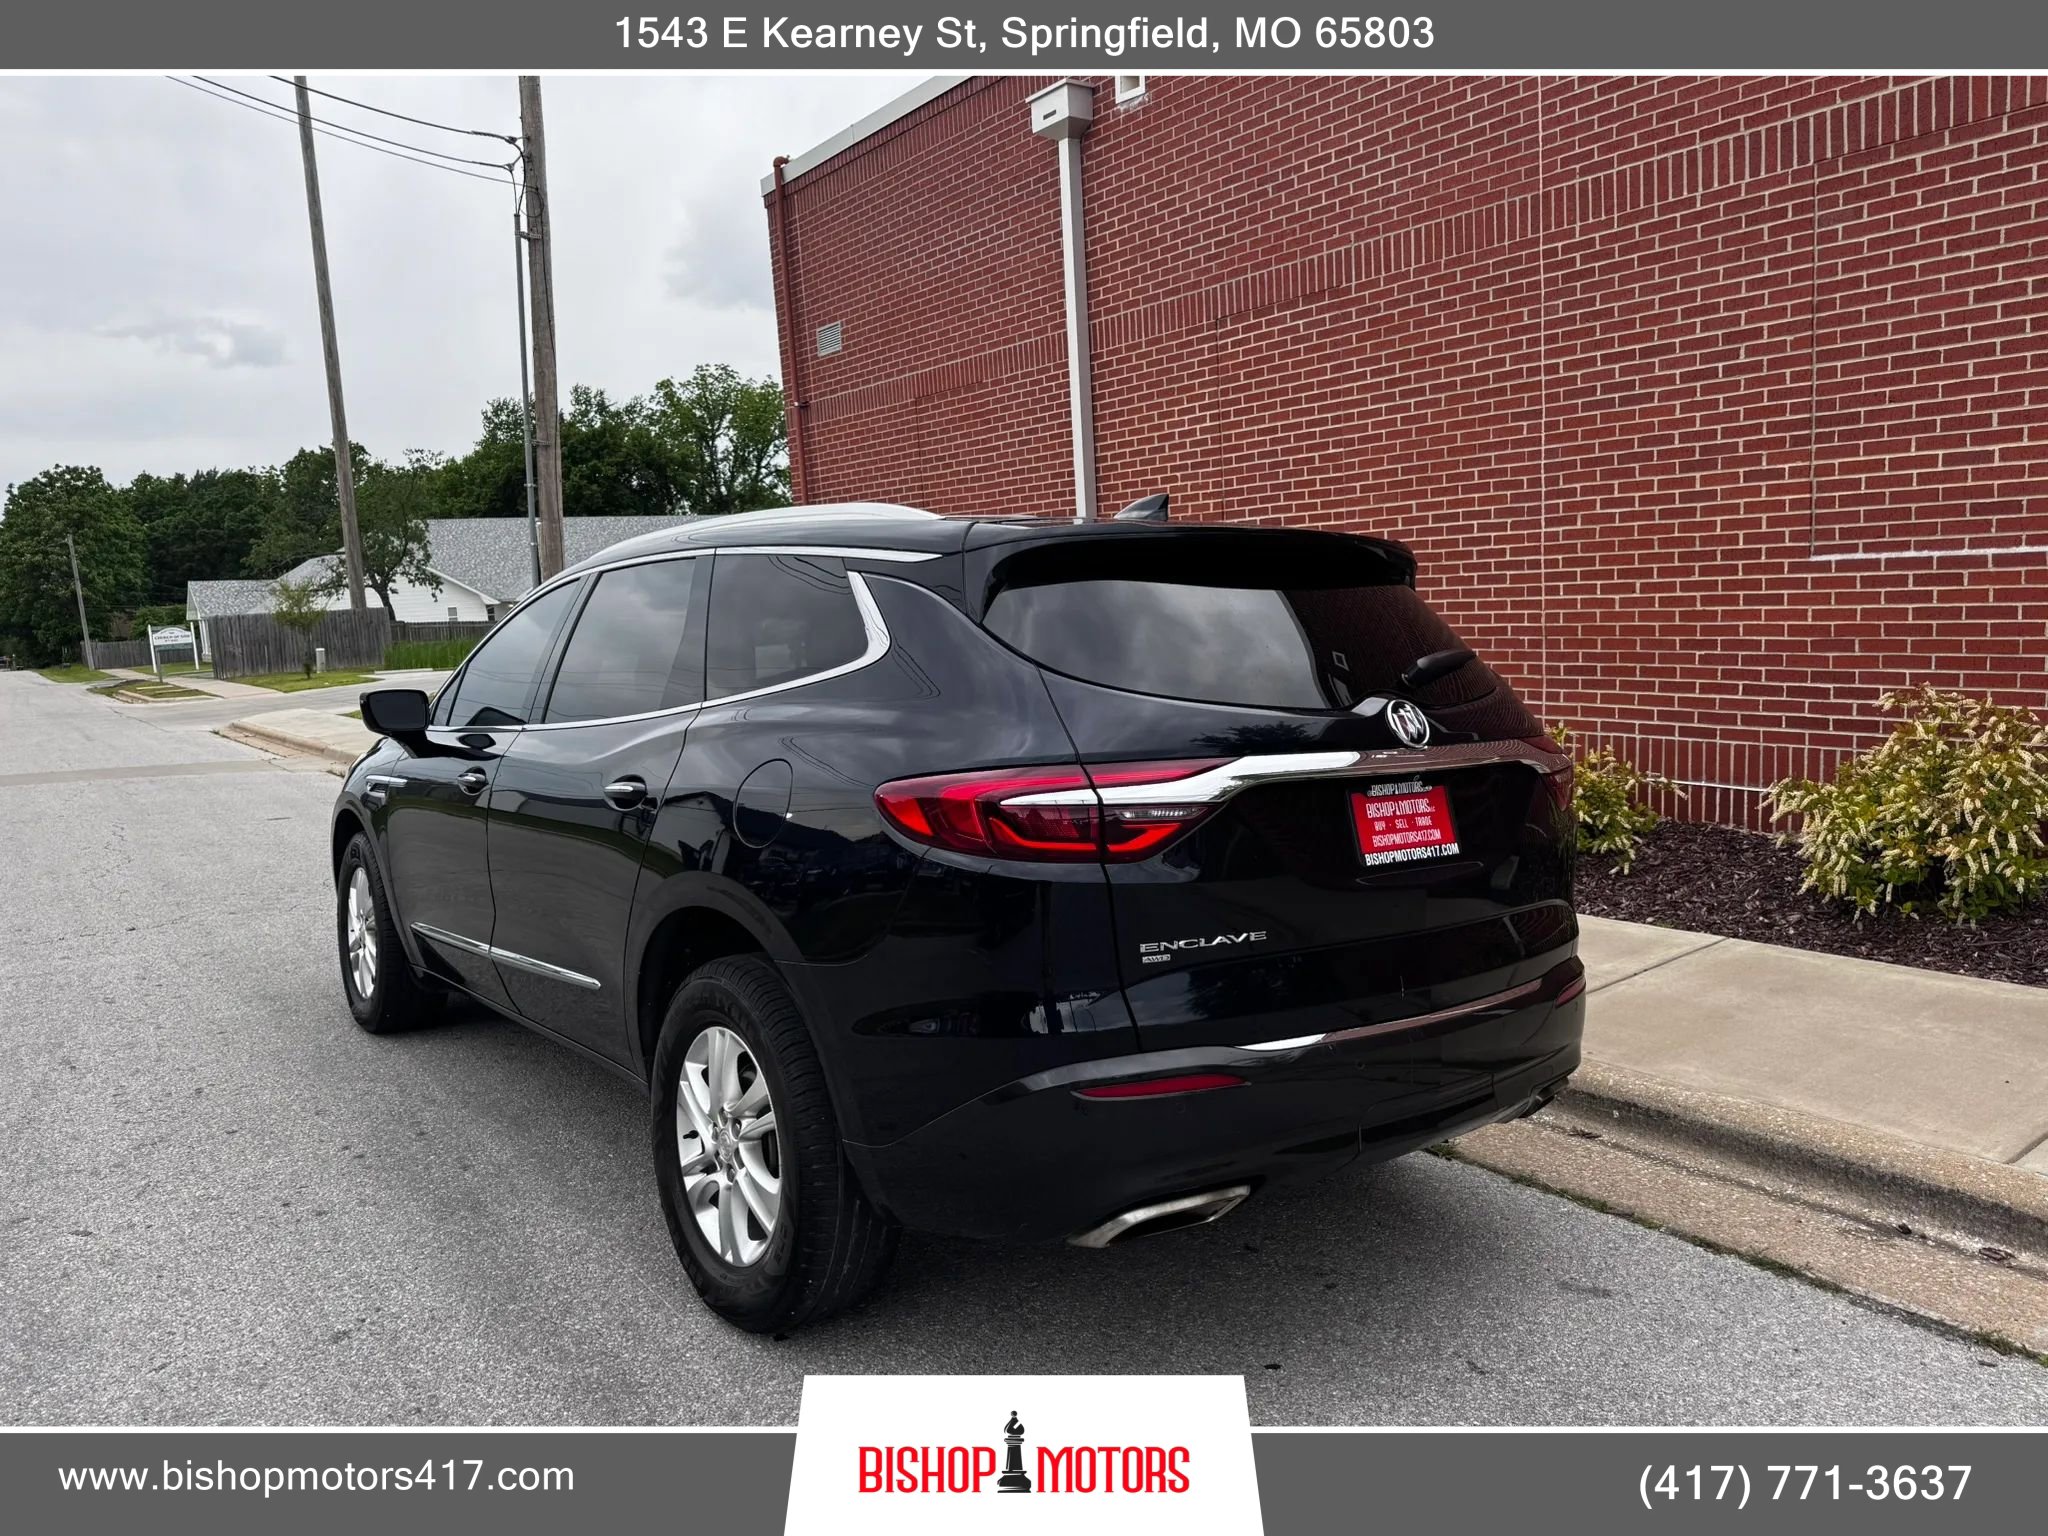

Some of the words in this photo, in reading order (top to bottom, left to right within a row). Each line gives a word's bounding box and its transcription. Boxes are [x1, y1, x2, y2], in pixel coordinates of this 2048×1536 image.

[1371, 783, 1395, 797] BISHOP
[1398, 781, 1423, 794] MOTORS
[1366, 801, 1396, 818] BISHOP
[1399, 798, 1430, 815] MOTORS
[1374, 820, 1386, 831] BUY
[1395, 818, 1409, 829] SELL
[1415, 815, 1433, 827] TRADE
[1372, 829, 1442, 848] BISHOPMOTORS417.COM
[1364, 842, 1460, 866] BISHOPMOTORS417.COM
[1139, 930, 1267, 953] ENCLAVE
[1142, 954, 1170, 964] AWD
